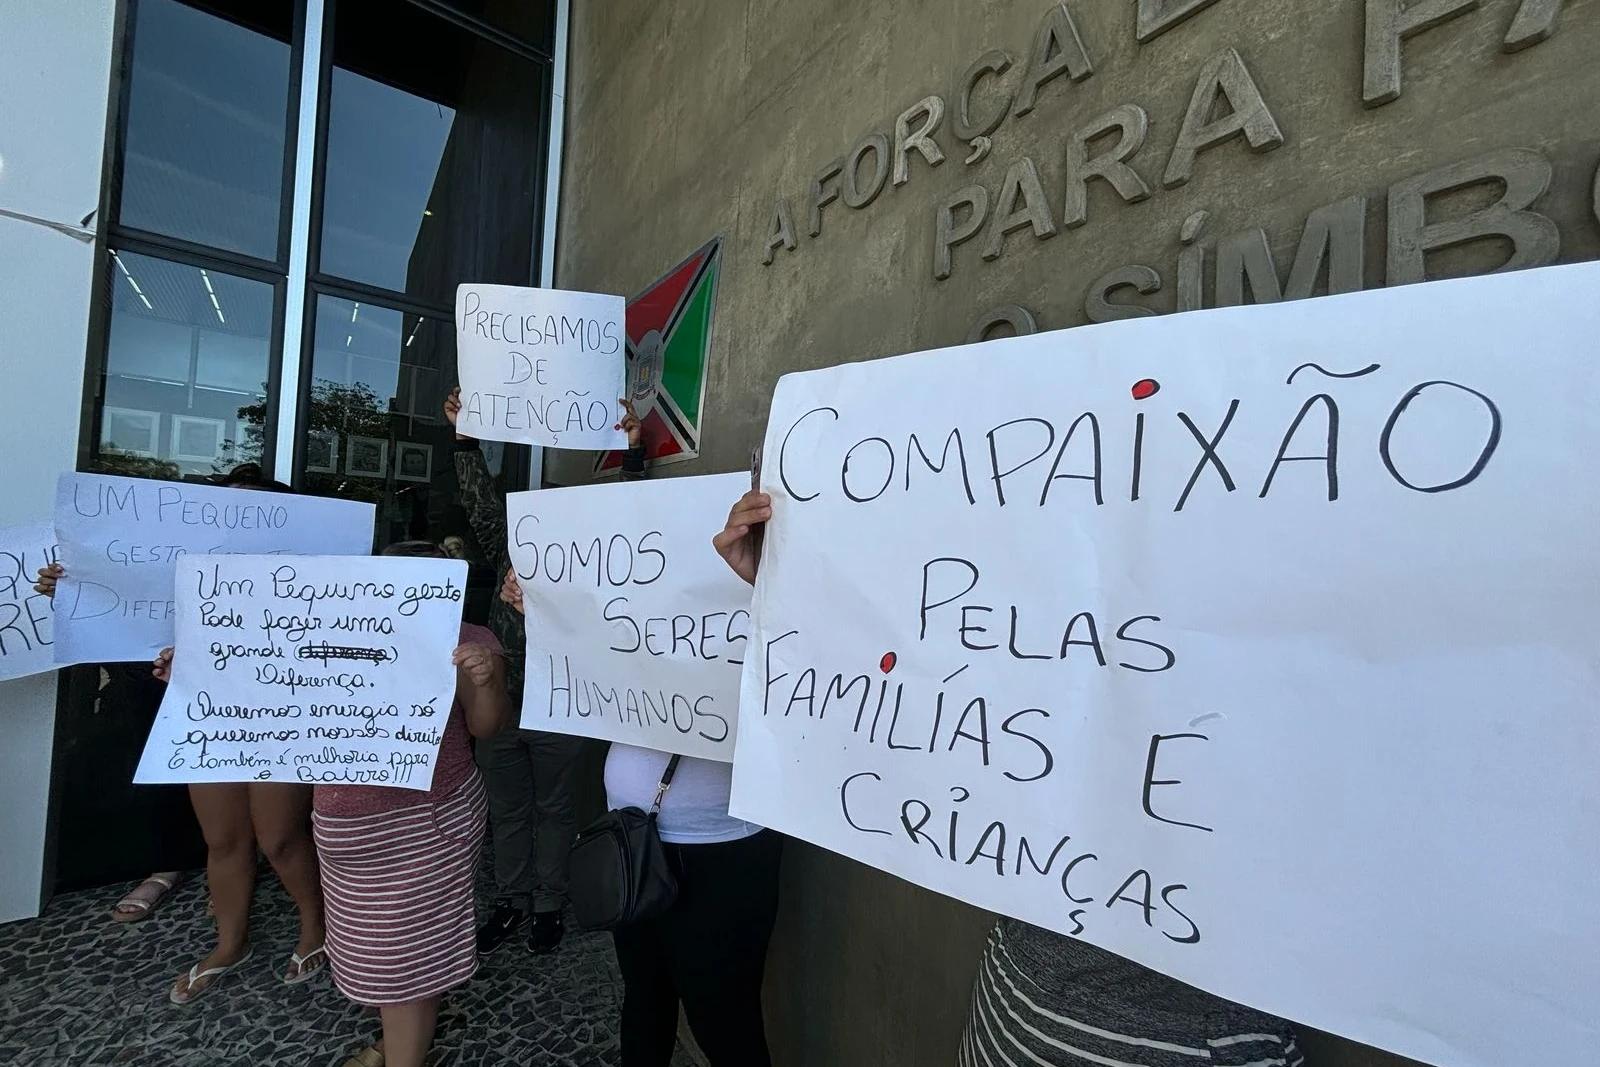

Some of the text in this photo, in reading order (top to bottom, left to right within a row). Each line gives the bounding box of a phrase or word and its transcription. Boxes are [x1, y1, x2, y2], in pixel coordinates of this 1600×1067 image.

[762, 2, 1094, 267] A FORÇA
[933, 47, 1285, 281] PARA
[1083, 146, 1600, 325] SÍMB
[463, 291, 619, 355] PRECISAMOS
[503, 351, 547, 386] DE
[74, 483, 288, 530] UM PEQUENO
[515, 514, 666, 587] SOMOS
[197, 563, 254, 600] Um
[398, 577, 462, 616] gesto
[200, 601, 395, 642] Pode fazer uma
[918, 557, 1177, 673] PELAS
[209, 640, 285, 671] grande
[603, 597, 750, 665] SERES
[187, 690, 437, 731] Queremos energia só
[549, 654, 729, 743] HUMANOS
[171, 728, 300, 754] queremos
[307, 726, 390, 741] nossos
[190, 750, 271, 770] também
[293, 746, 380, 767] melhoria
[386, 751, 429, 770] para
[839, 771, 1201, 944] CRIANÇAS
